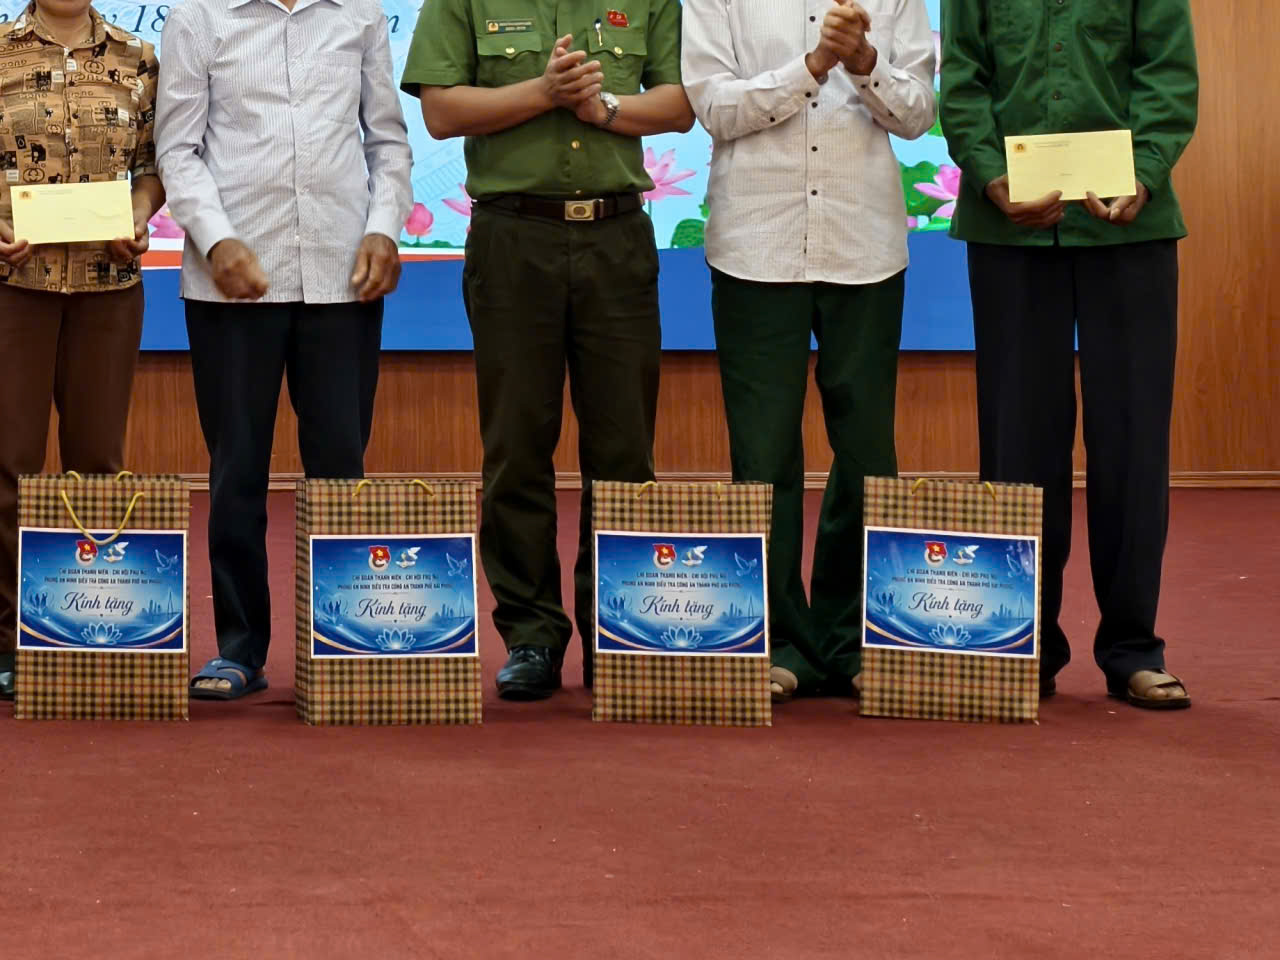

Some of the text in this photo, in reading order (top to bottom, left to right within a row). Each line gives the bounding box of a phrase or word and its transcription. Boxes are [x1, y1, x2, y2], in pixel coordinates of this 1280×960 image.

[60, 591, 135, 616] Kính tặng
[355, 598, 428, 621] Kính tặng
[639, 595, 715, 620] Kính tặng
[908, 592, 984, 619] Kính tặng
